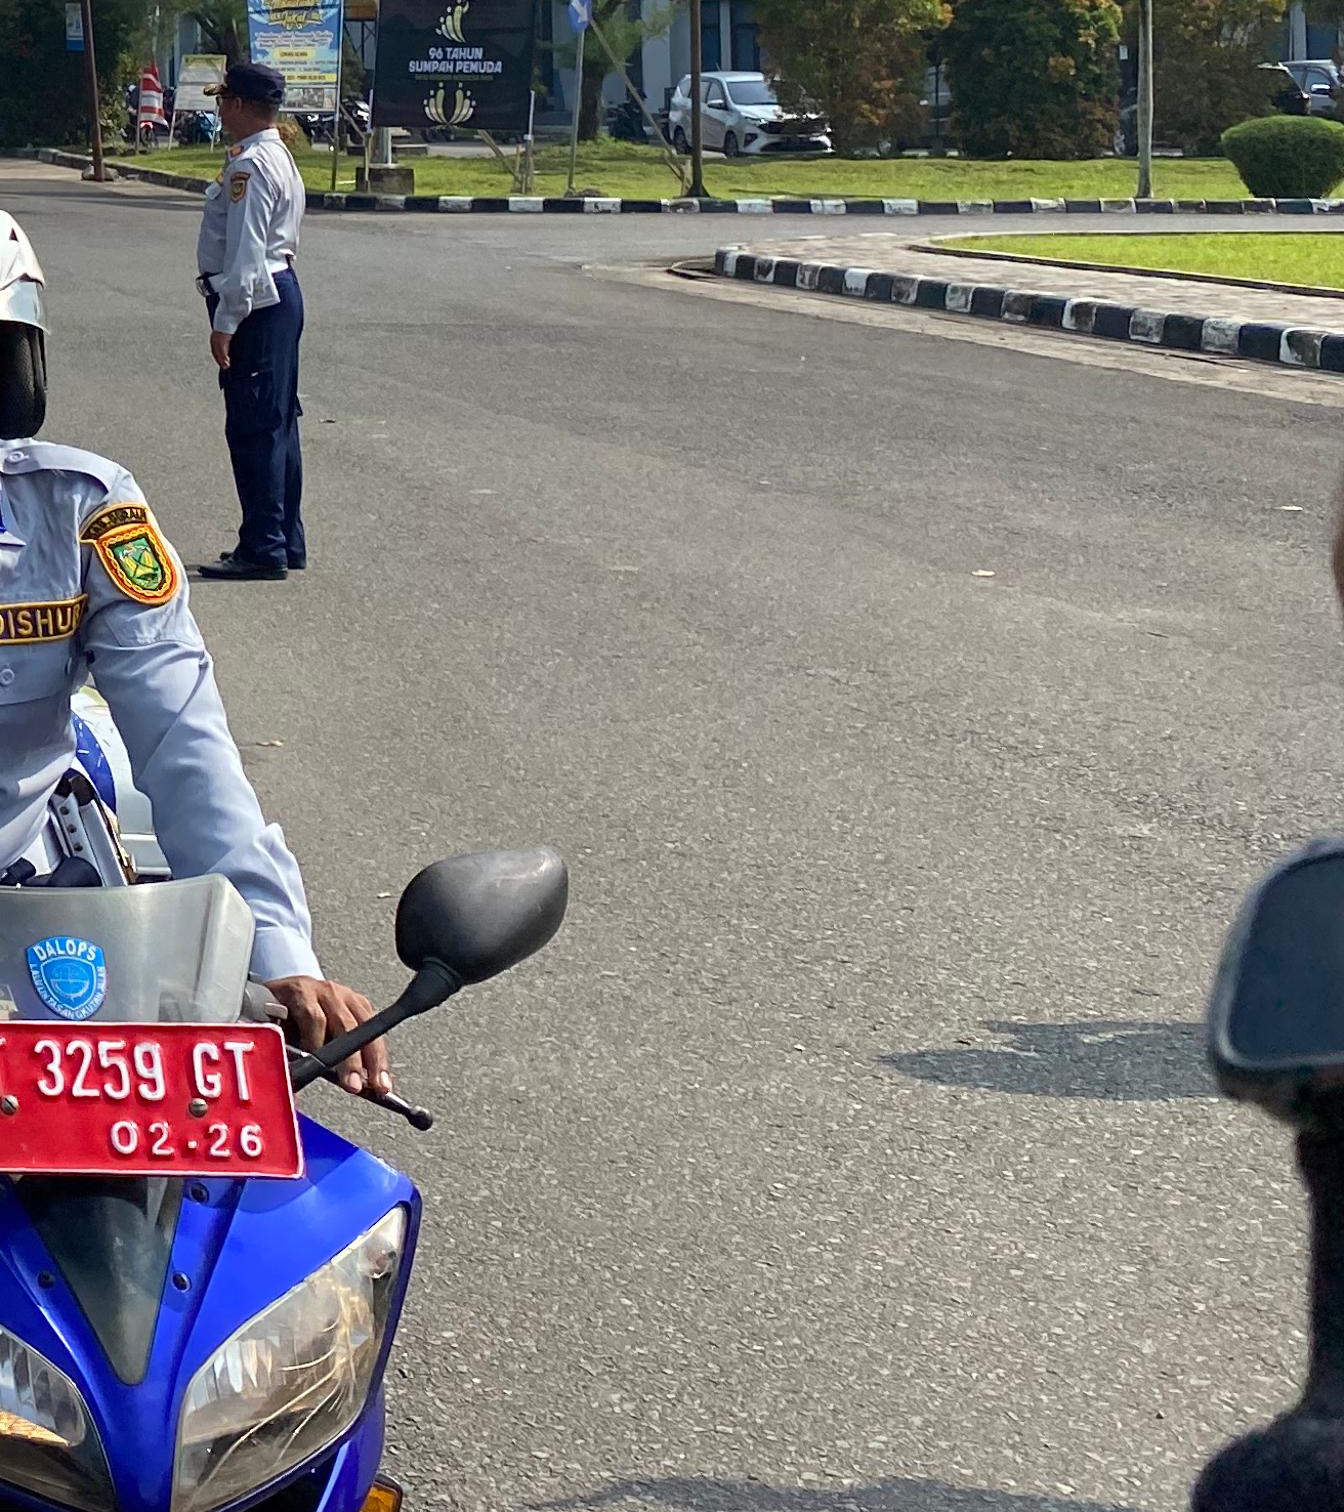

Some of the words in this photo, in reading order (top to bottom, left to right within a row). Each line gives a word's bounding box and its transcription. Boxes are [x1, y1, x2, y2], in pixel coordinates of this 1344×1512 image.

[428, 47, 444, 59] 96
[446, 47, 483, 59] TAHUN
[408, 60, 454, 73] SUMPAH
[455, 60, 502, 73] PEMUDA
[33, 938, 97, 961] DALOPS
[33, 1039, 166, 1102] 3259
[192, 1040, 256, 1102] GT
